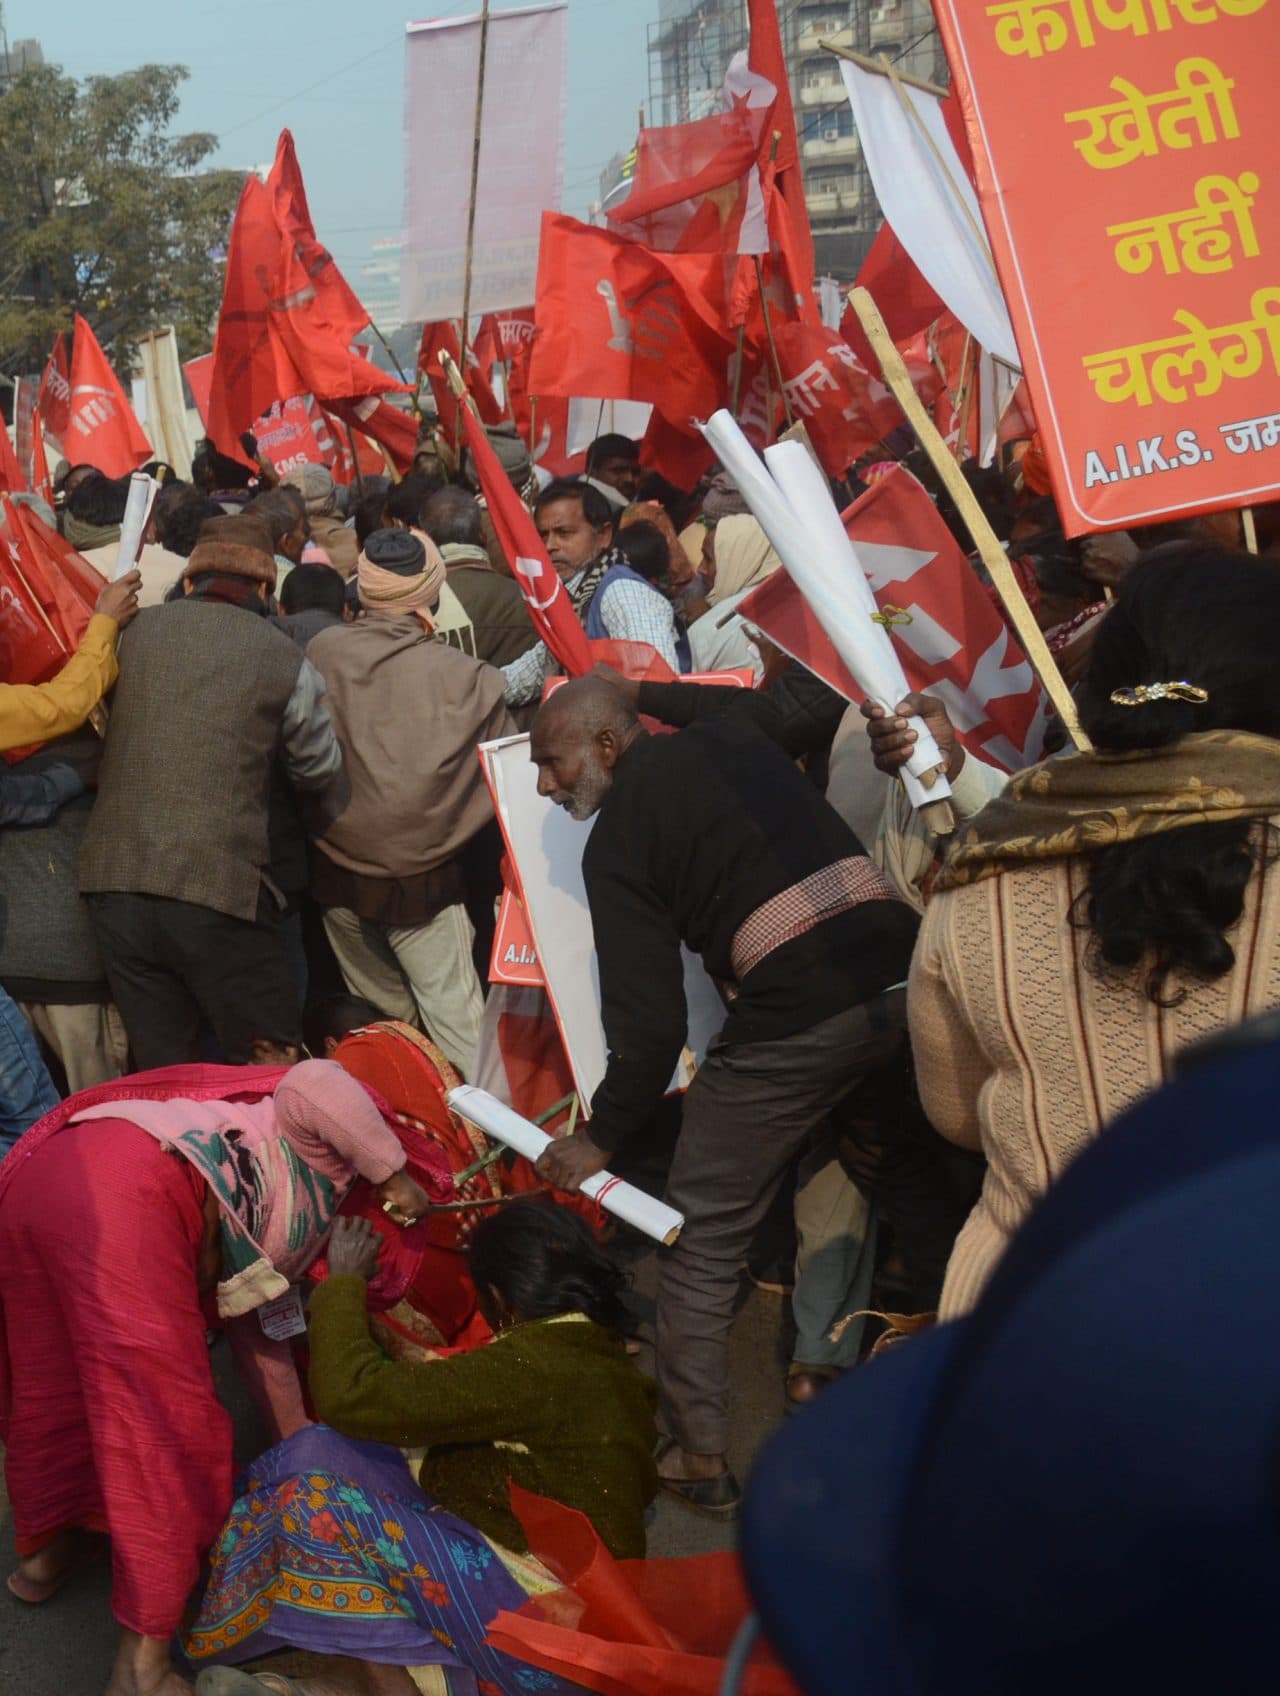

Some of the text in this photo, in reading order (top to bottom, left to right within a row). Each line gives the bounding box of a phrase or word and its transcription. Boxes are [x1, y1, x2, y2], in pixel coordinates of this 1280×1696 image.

[1064, 57, 1241, 170] खेती
[1106, 171, 1261, 275] नहीं
[1084, 429, 1213, 488] A.I.K.S.
